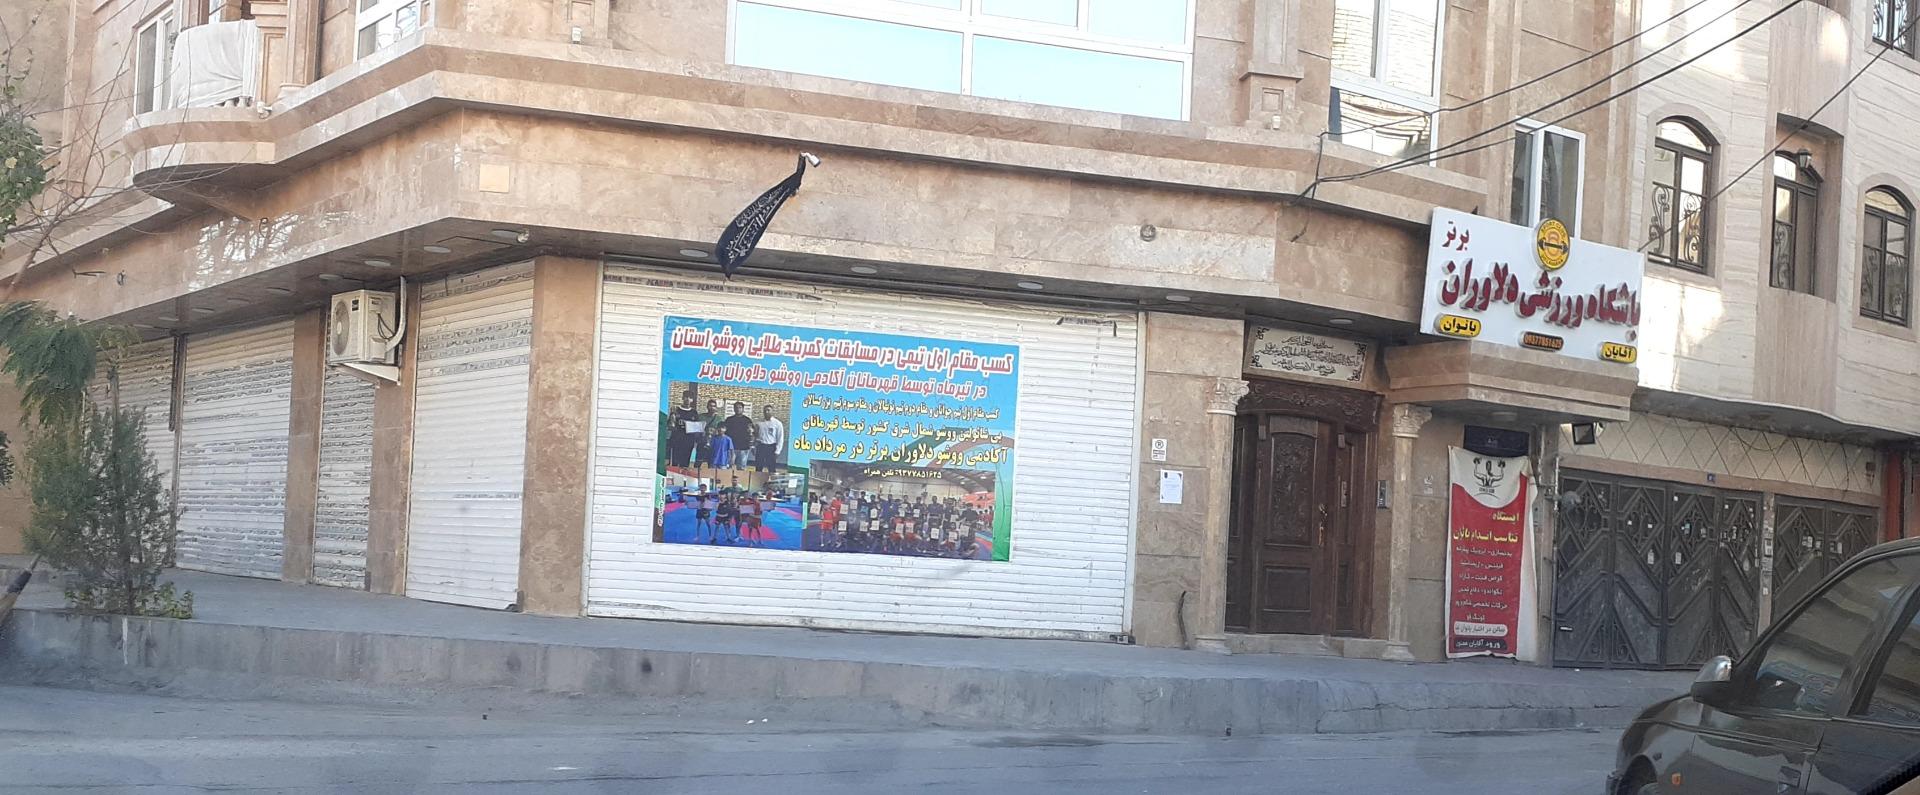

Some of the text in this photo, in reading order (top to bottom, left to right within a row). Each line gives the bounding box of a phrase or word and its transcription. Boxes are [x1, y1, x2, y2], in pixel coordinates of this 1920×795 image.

[1442, 221, 1470, 251] برتر
[1440, 258, 1641, 342] باشگاه ورزشی دلاوران
[1443, 319, 1477, 337] بانوان
[672, 327, 1013, 378] کسب مقام اول تیمی در مسابقات کمربند طلایی ووشو استان
[1604, 344, 1632, 360] آقایان
[698, 360, 986, 400] در تیرماه توسط قهرمانان آکادمی ووشو دلاوران برتر
[843, 399, 855, 412] سوم
[855, 396, 868, 412] مقام
[868, 404, 872, 413] و
[905, 402, 916, 417] دوم
[917, 401, 928, 417] مقام
[934, 404, 953, 420] جوانان
[929, 409, 933, 418] و
[962, 405, 973, 421] اول
[973, 406, 985, 419] مقام
[985, 408, 1000, 422] کسب
[802, 414, 839, 432] قهرمانان
[841, 417, 865, 435] توسط
[866, 419, 889, 437] کشور
[891, 421, 910, 438] شرق
[911, 422, 934, 439] شمال
[935, 424, 957, 442] ووشو
[793, 433, 1009, 466] آکادمی ووشو دلاوران برتر در مرداد ماه
[863, 467, 881, 477] همراه
[1492, 511, 1520, 525] ایستگاه
[1493, 532, 1519, 543] تناسب
